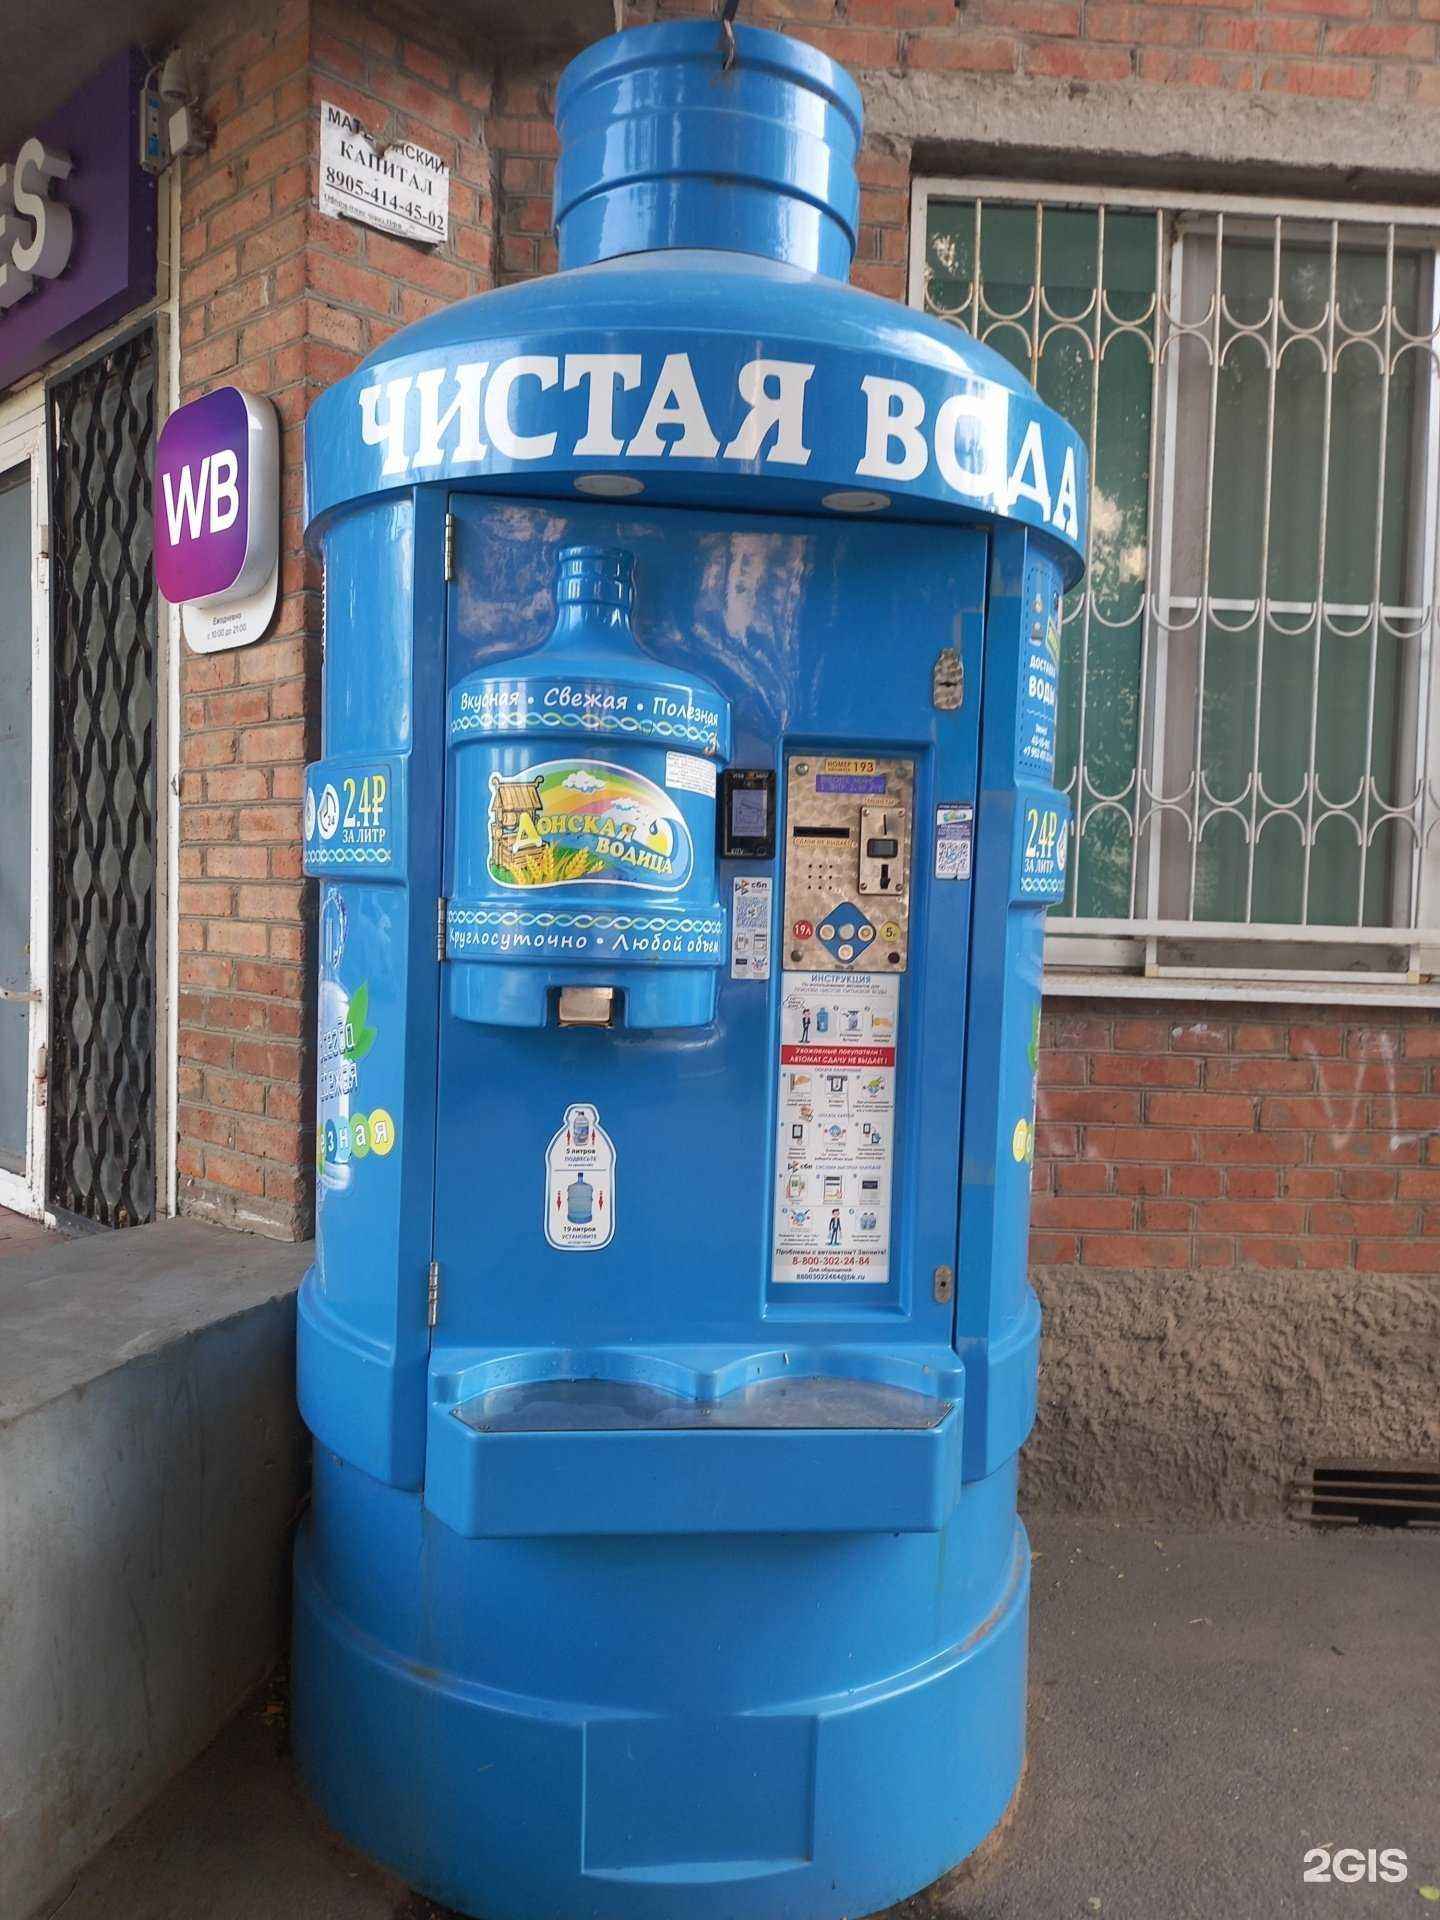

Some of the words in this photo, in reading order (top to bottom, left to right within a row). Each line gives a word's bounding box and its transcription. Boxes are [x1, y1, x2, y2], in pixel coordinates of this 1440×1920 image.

[340, 140, 433, 196] КАПИТАЛ
[325, 165, 445, 231] 8905-414-45-02
[359, 352, 815, 477] ЧИСТАЯ
[854, 375, 1080, 541] ВОДА
[161, 449, 240, 547] WB
[543, 685, 629, 711] Свежая
[653, 696, 719, 727] Полезная
[854, 761, 874, 773] 193
[355, 828, 386, 844] ЛИТР
[594, 836, 675, 875] ВОДИЦА
[449, 927, 588, 951] Круглосуточно
[611, 932, 682, 952] Любой
[811, 975, 871, 984] ИНСТРУКЦИЯ
[792, 1256, 870, 1265] 8-800-302-24-84
